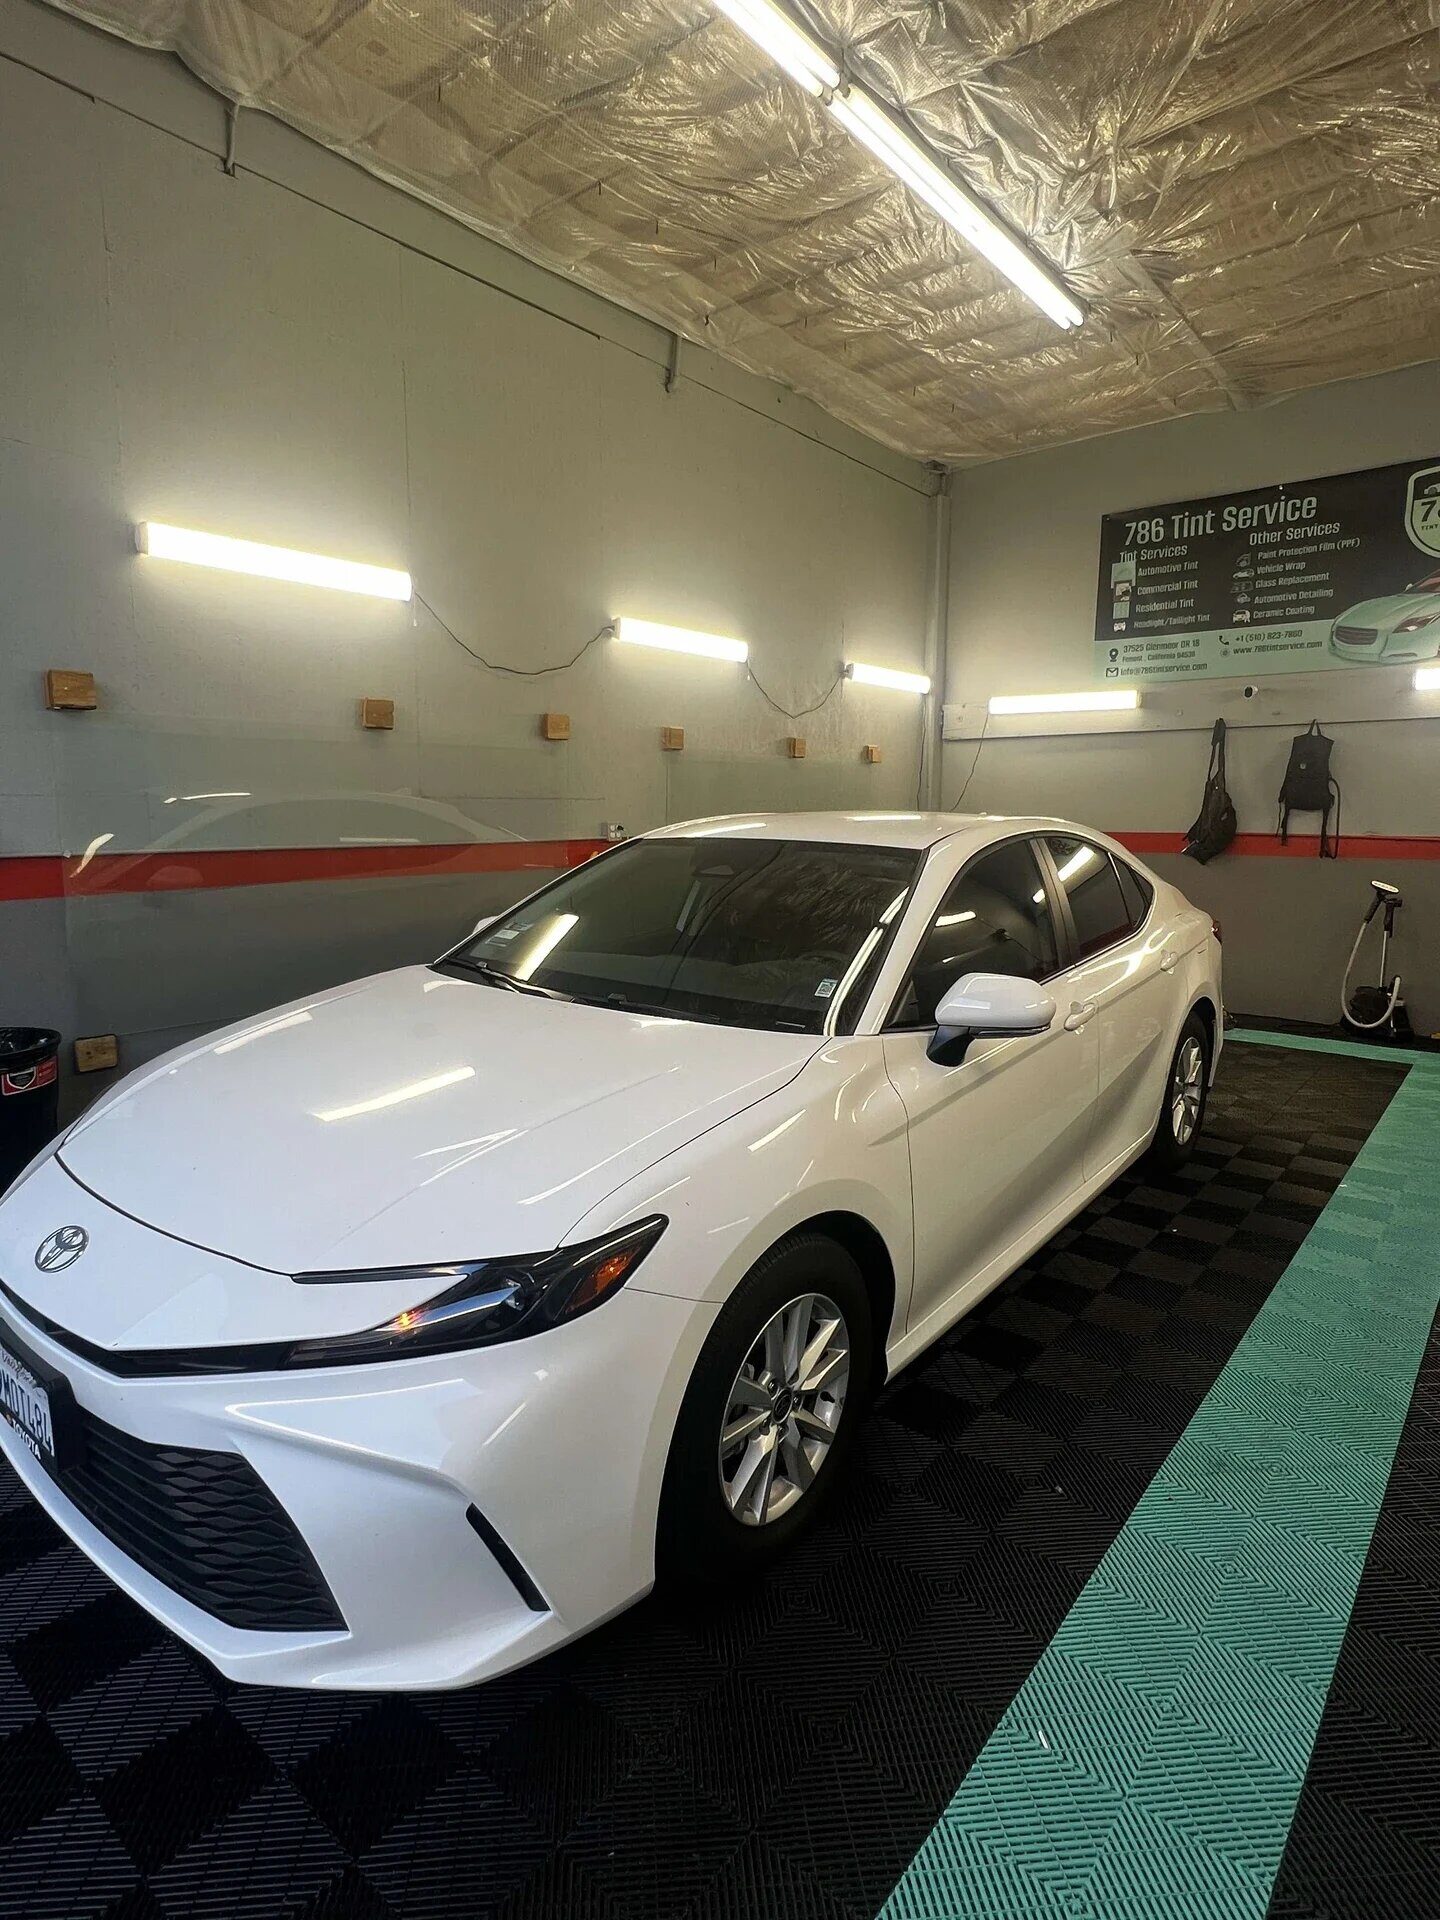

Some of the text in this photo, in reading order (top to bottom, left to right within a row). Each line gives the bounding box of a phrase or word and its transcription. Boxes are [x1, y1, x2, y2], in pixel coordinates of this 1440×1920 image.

[1421, 499, 1440, 522] 7
[1124, 495, 1317, 546] 786 Tint Service
[1249, 522, 1341, 546] Other Services
[1119, 544, 1188, 563] Tint Services
[1257, 537, 1360, 560] Paint Protection Film (PPF)
[1137, 560, 1199, 577] Automotive Tint
[1256, 561, 1306, 575] Vehicle Wrap
[1137, 579, 1199, 596] Commercial Tint
[1255, 572, 1330, 589] Glass Replacement
[1254, 588, 1334, 604] Automotive Detailing
[1135, 598, 1194, 613] Residential Tint
[1253, 605, 1316, 620] Ceramic Coating
[1197, 613, 1211, 623] Tint
[1123, 643, 1145, 653] 37525
[1145, 641, 1179, 651] Glenmoor
[1180, 639, 1191, 649] DR
[12, 1417, 42, 1460] TOYOTA
